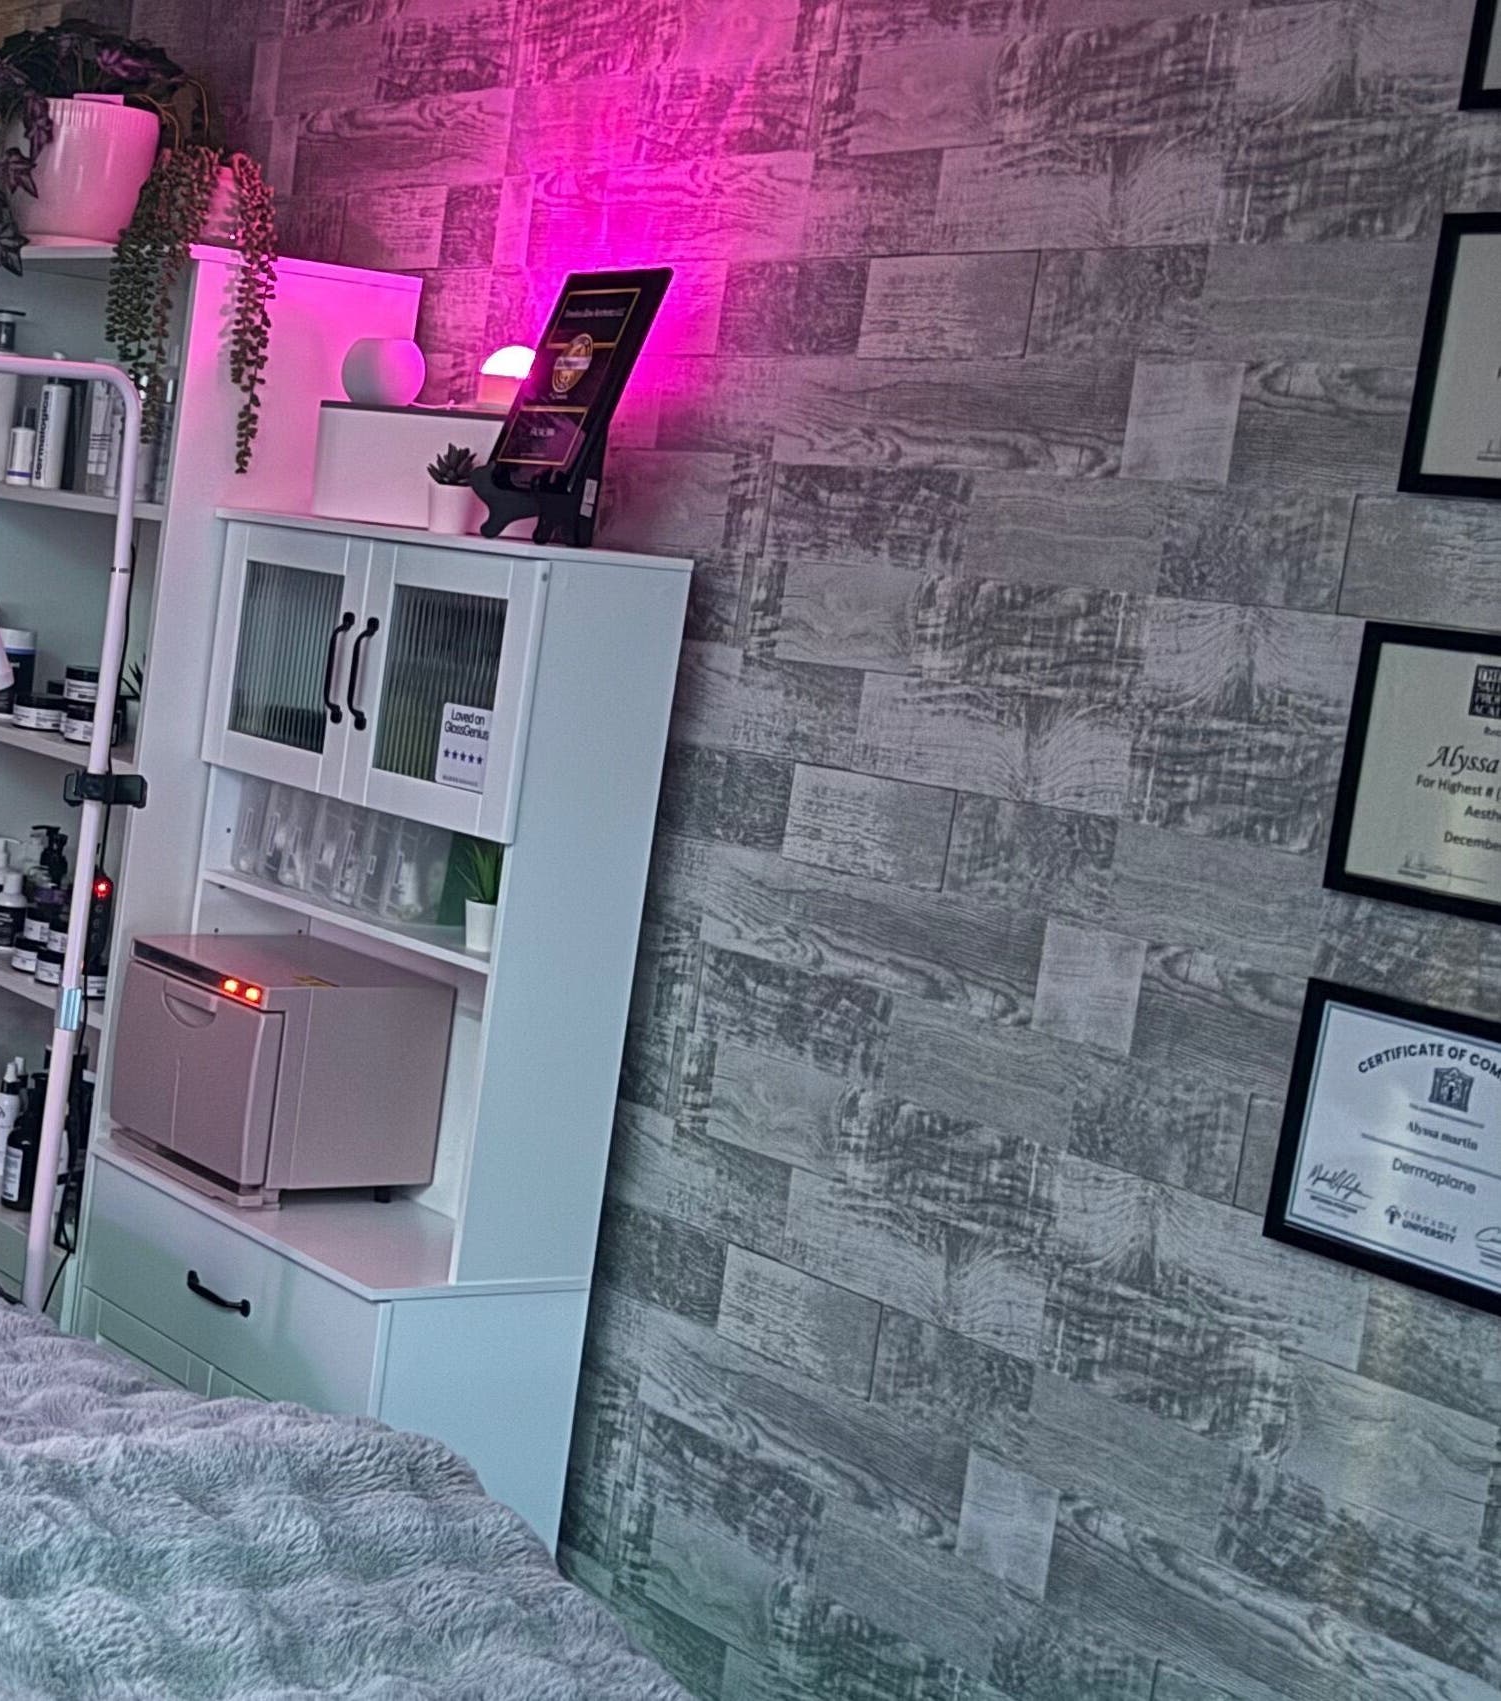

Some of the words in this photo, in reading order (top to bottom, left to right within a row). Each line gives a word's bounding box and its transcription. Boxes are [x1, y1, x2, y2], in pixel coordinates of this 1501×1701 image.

[35, 391, 50, 480] dermalogica
[444, 720, 490, 741] GlossGenius
[450, 708, 474, 724] Loved
[474, 714, 486, 726] on
[1427, 745, 1500, 776] Alyssa
[1416, 774, 1436, 789] For
[1437, 778, 1483, 797] Highest
[1485, 786, 1494, 798] #
[1443, 830, 1501, 852] Decembe
[1358, 1043, 1445, 1073] CERTIFICATE
[1447, 1046, 1468, 1061] OF
[1469, 1053, 1501, 1079] COM
[1406, 1120, 1440, 1140] Alyssa
[1440, 1131, 1479, 1151] martin
[1391, 1157, 1478, 1195] Dermaplane
[1401, 1219, 1457, 1244] UNIVERSITY
